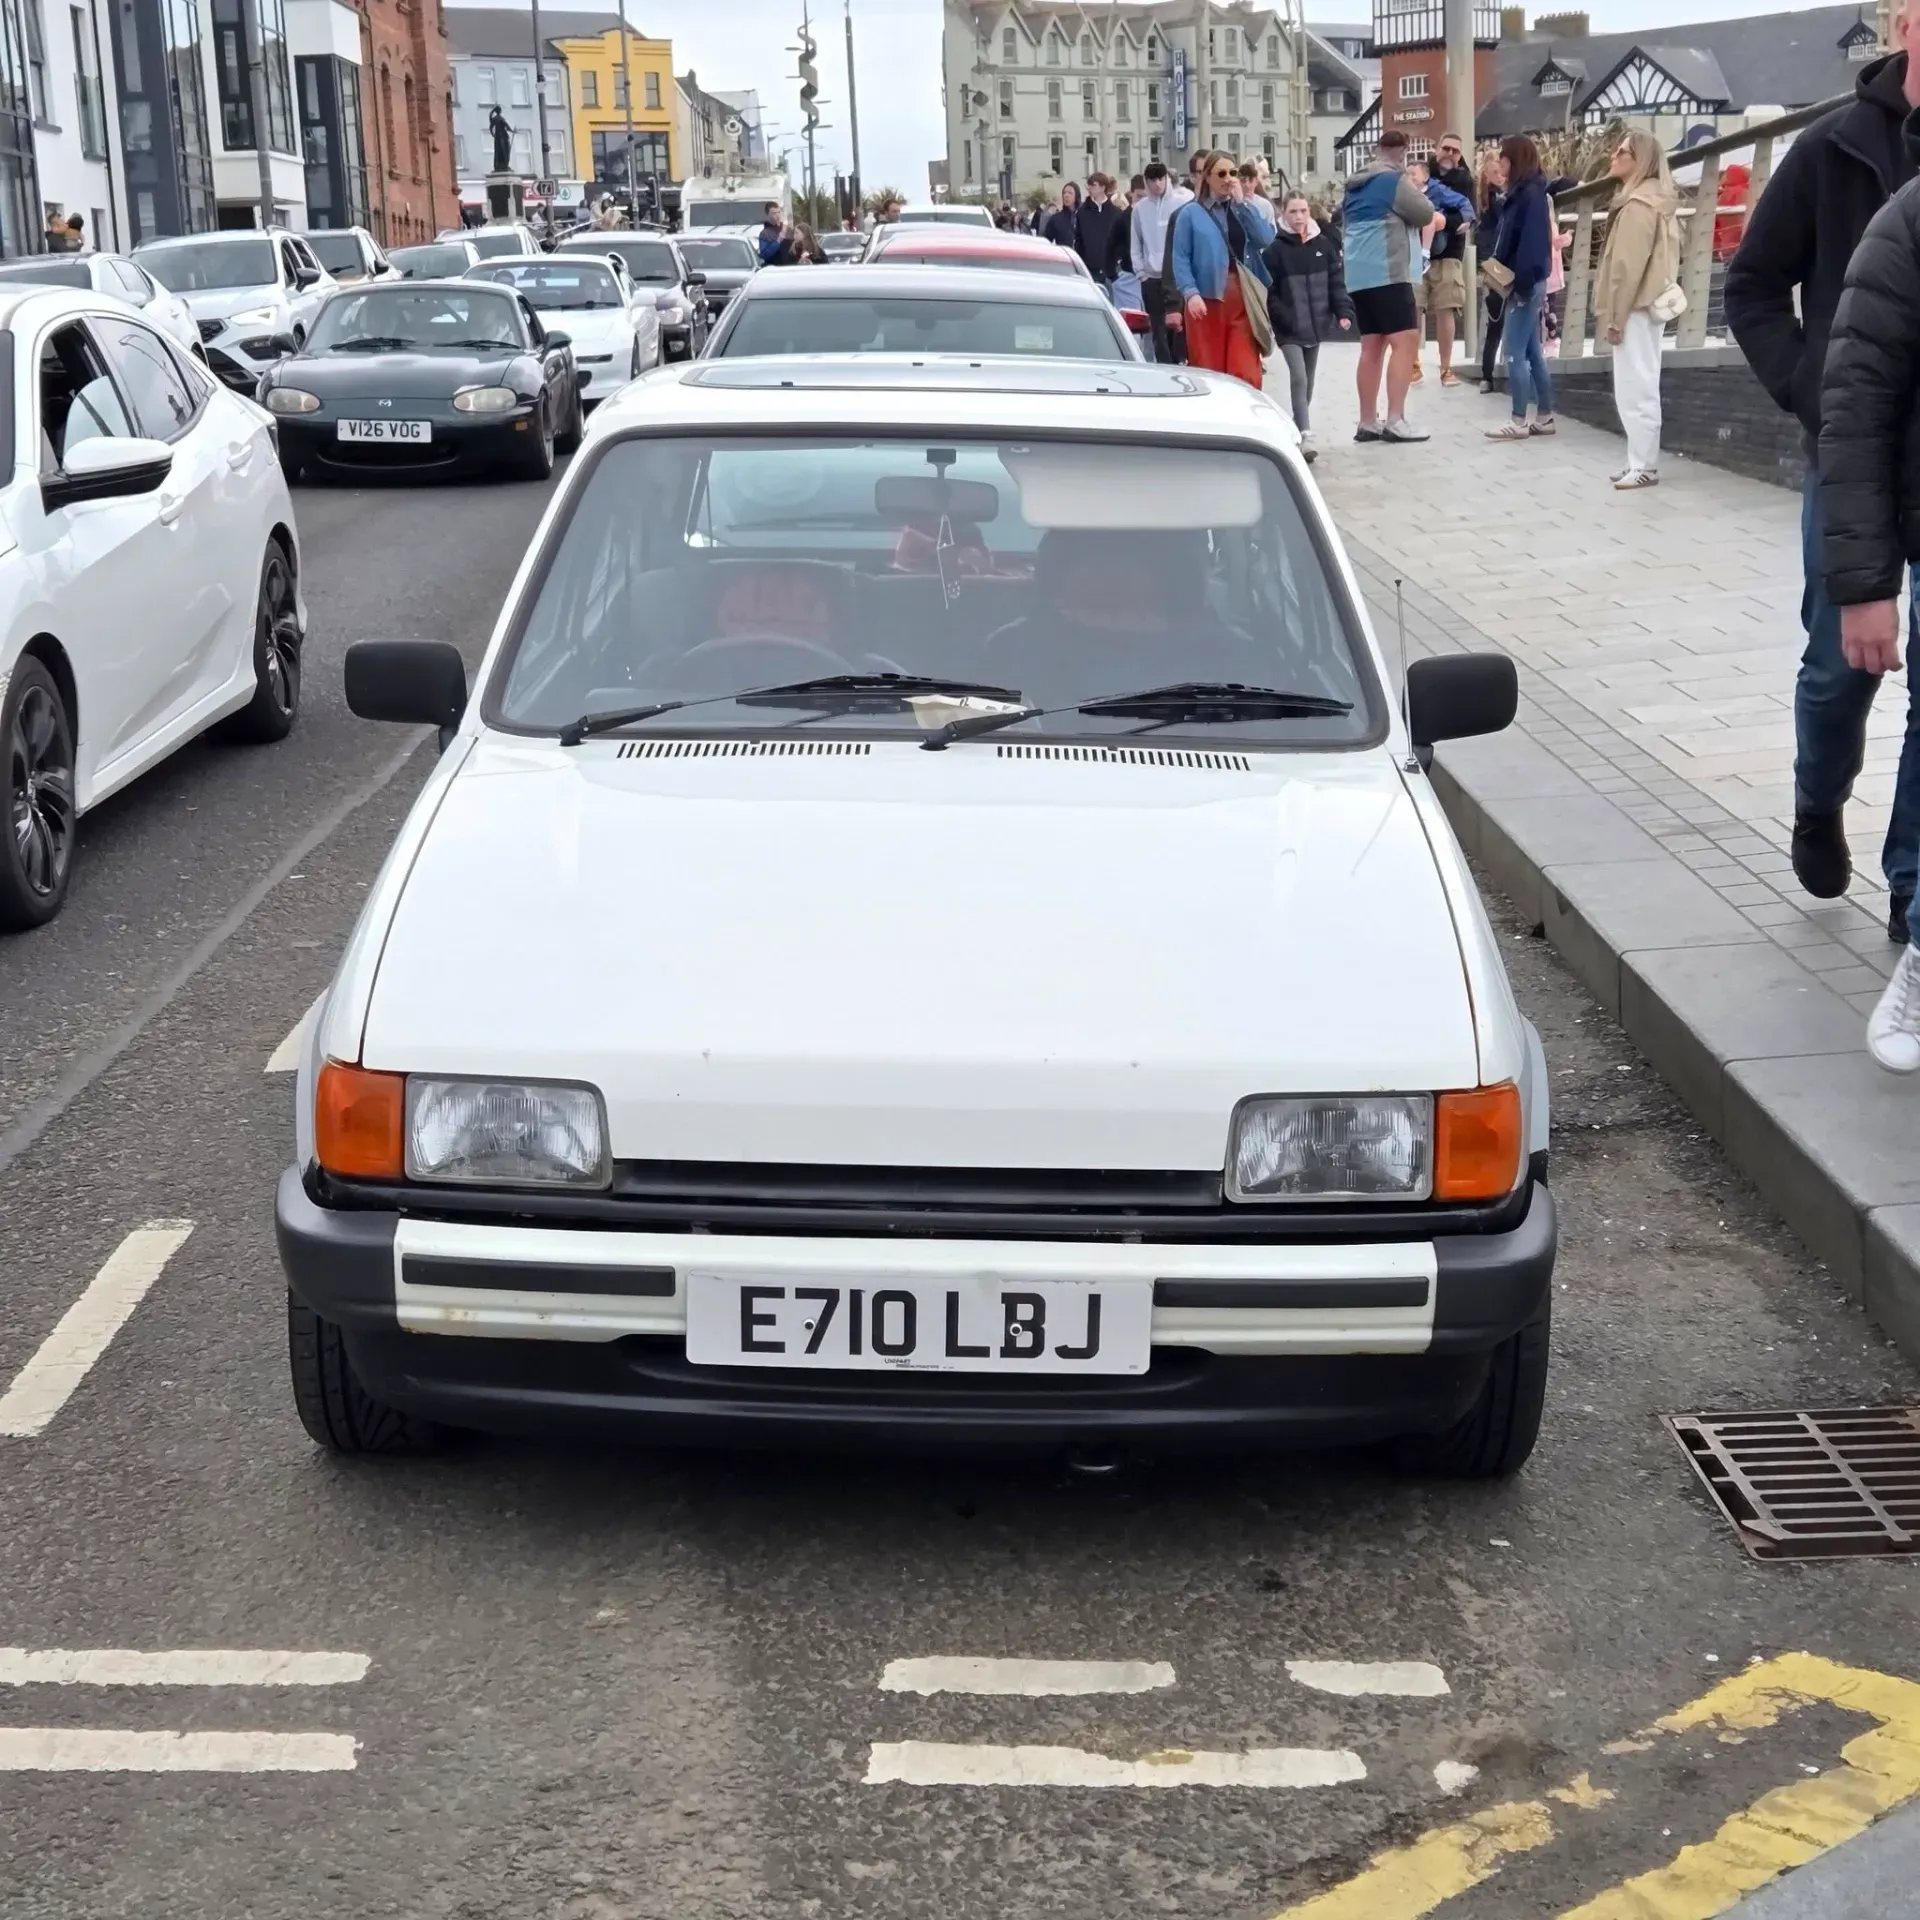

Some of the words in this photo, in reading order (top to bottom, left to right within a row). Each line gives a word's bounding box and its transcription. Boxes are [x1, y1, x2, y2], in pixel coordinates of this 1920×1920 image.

[1175, 52, 1184, 145] HOTEL
[348, 421, 384, 437] V126
[389, 422, 420, 438] VOG
[740, 1285, 917, 1357] E710
[945, 1290, 1102, 1360] LBJ
